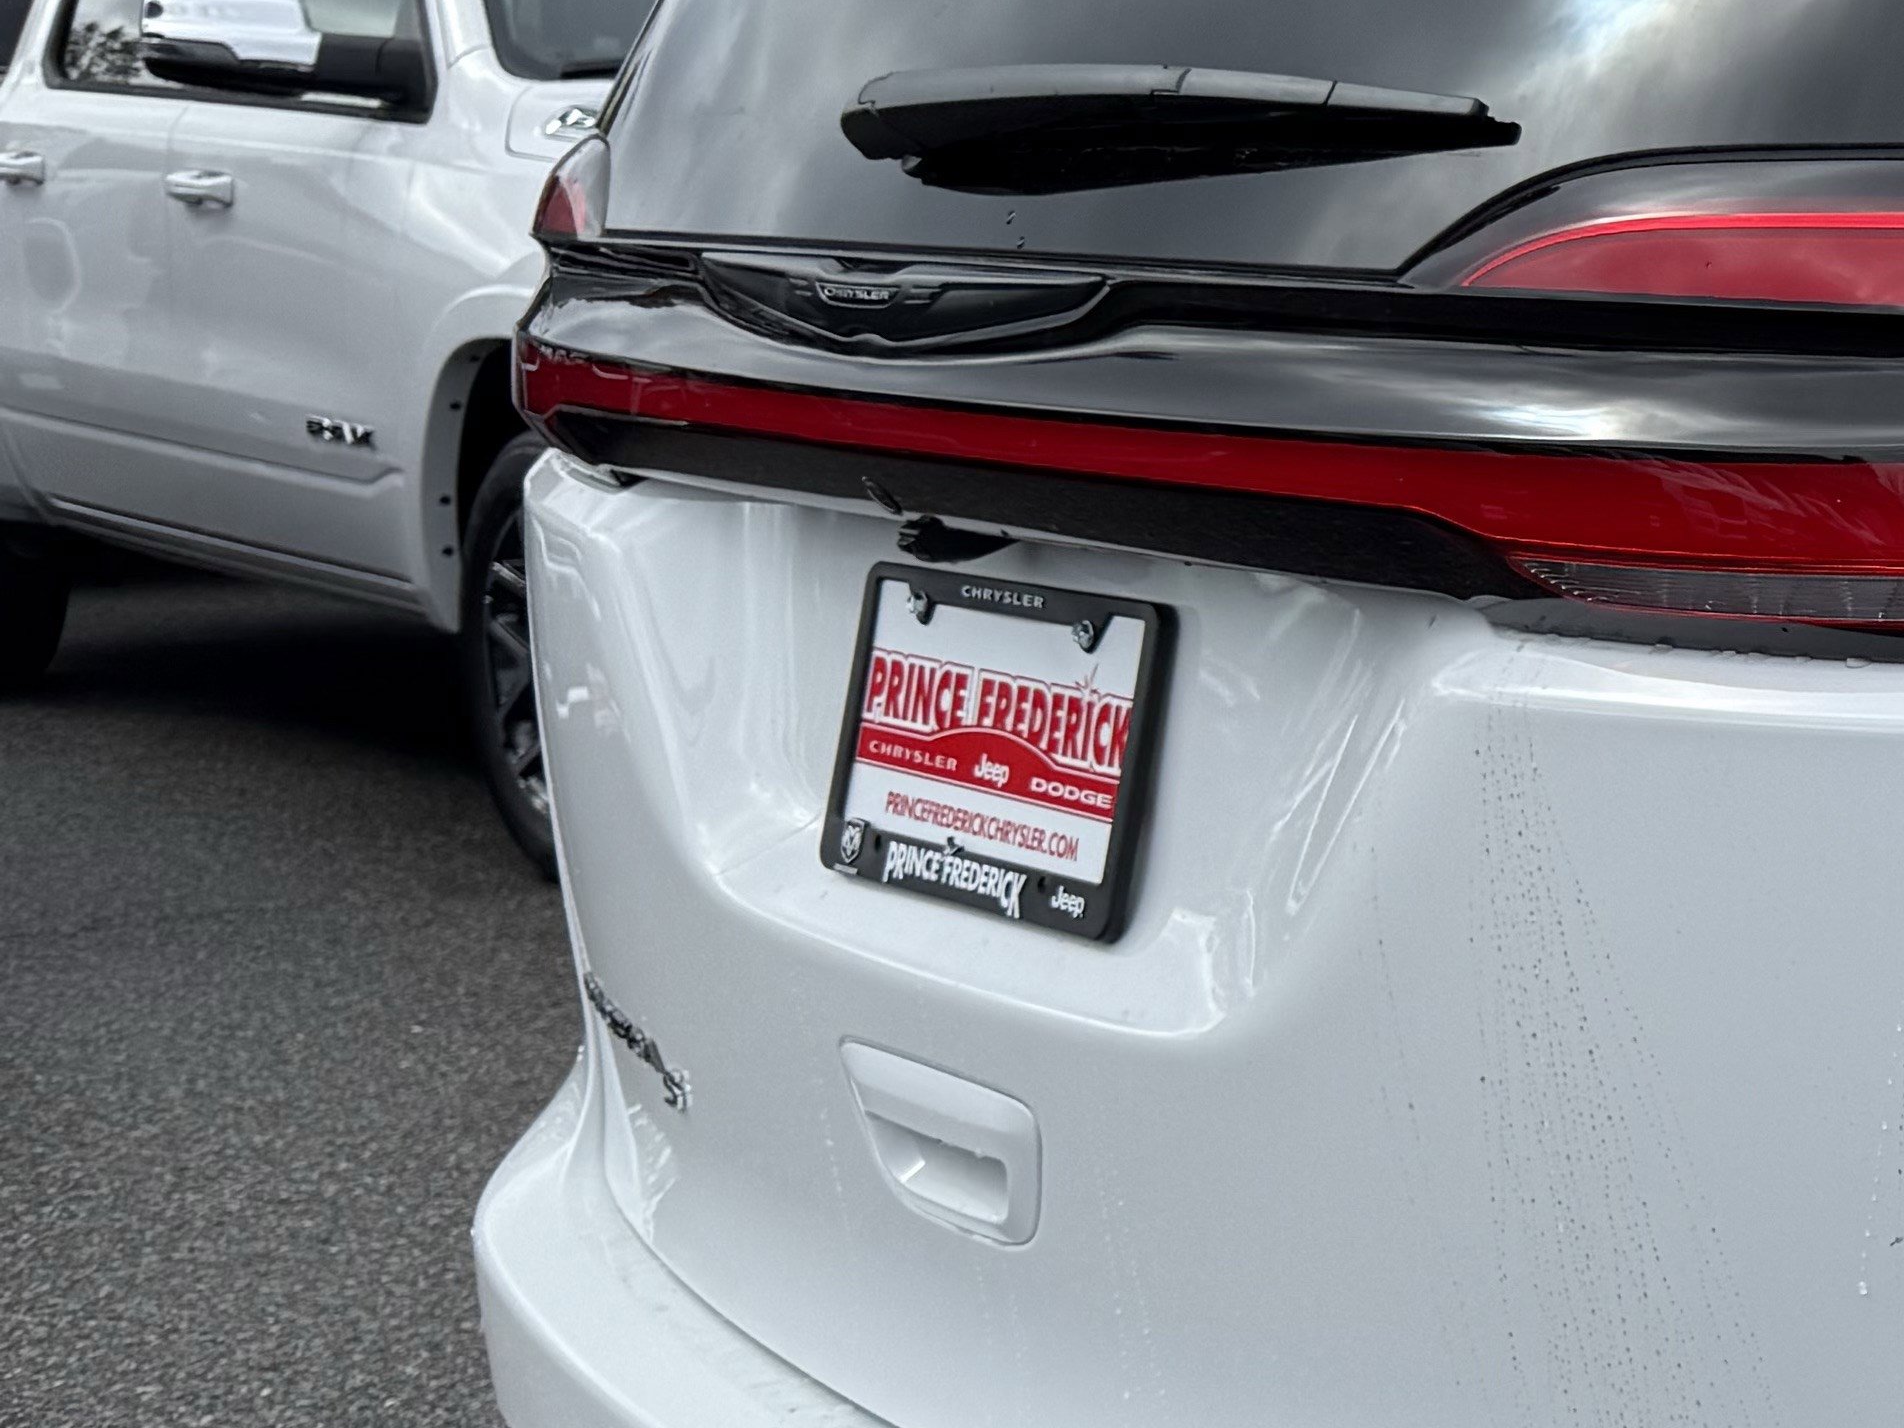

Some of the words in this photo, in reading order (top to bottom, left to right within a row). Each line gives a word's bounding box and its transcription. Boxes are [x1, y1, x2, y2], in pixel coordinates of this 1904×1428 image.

[960, 584, 1045, 609] CHRYSLER
[865, 655, 969, 730] PRINCE
[976, 678, 1132, 771] FREDERICK
[868, 739, 958, 772] CHRYSLER
[974, 753, 1010, 788] Jeep
[1030, 777, 1113, 810] DODGE
[885, 791, 1080, 862] PRINCEFREDERICKCHRYSLER.COM
[882, 841, 942, 883] PRINCE
[940, 856, 1028, 919] FREDERICK
[1051, 886, 1086, 918] Jeep
